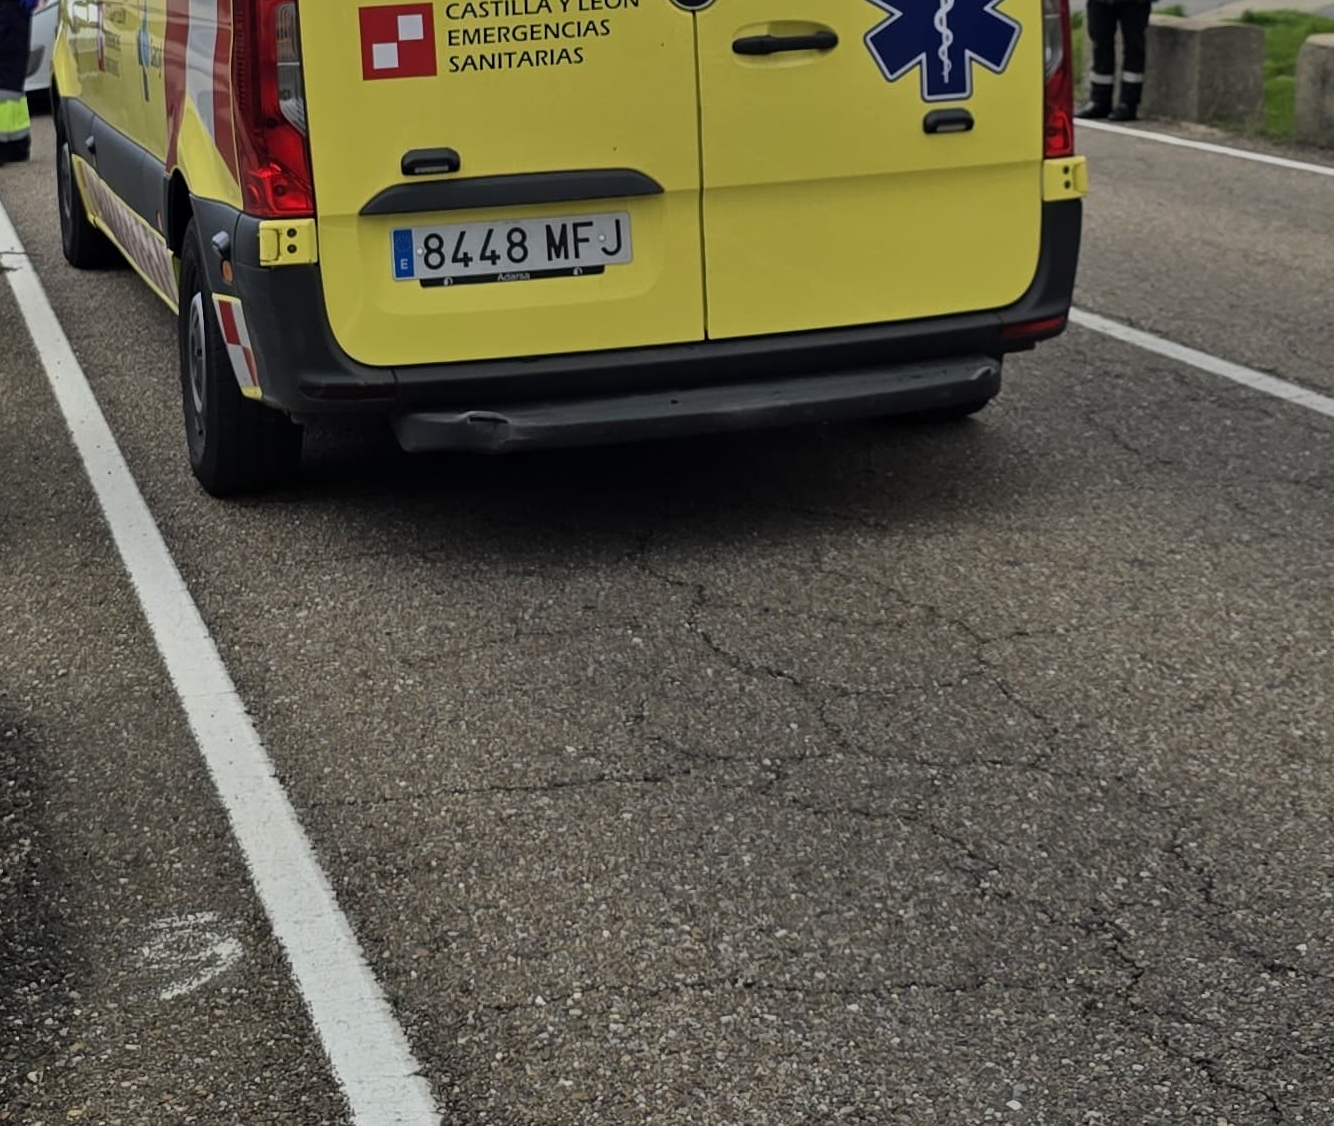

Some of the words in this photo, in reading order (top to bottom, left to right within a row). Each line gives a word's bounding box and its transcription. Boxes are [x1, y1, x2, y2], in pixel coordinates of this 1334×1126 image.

[447, 19, 611, 46] EMERGENCIAS
[449, 47, 584, 73] SANITARIAS
[423, 227, 529, 270] 8448
[545, 219, 622, 261] MFJ
[400, 258, 409, 270] E
